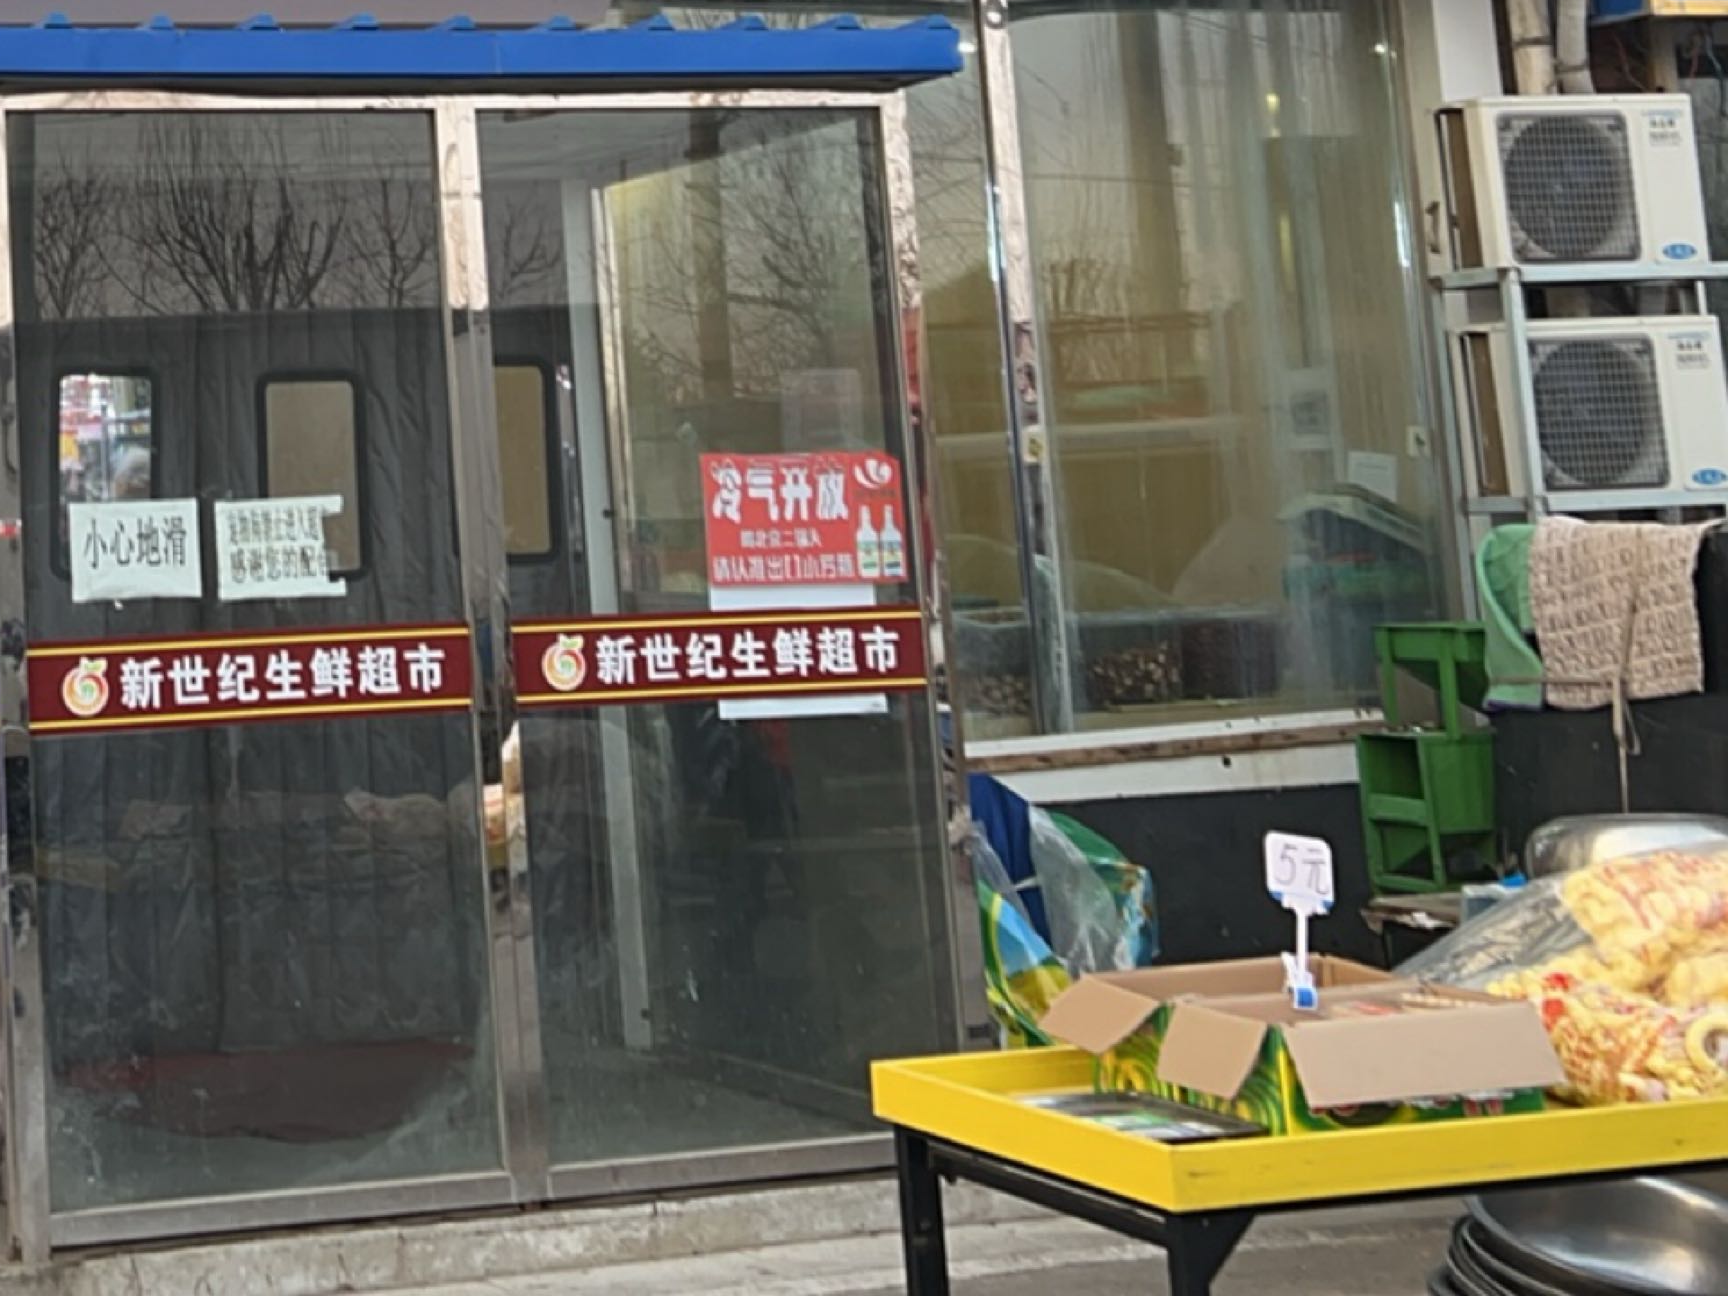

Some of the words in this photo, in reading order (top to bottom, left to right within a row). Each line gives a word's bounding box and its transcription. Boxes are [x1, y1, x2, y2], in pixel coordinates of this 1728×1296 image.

[710, 456, 849, 524] 冷气开放
[83, 516, 187, 570] 小心地滑
[119, 642, 446, 710] 新世纪生鲜超市
[596, 625, 900, 685] 新世纪生鲜超市
[1274, 842, 1329, 895] 5元
